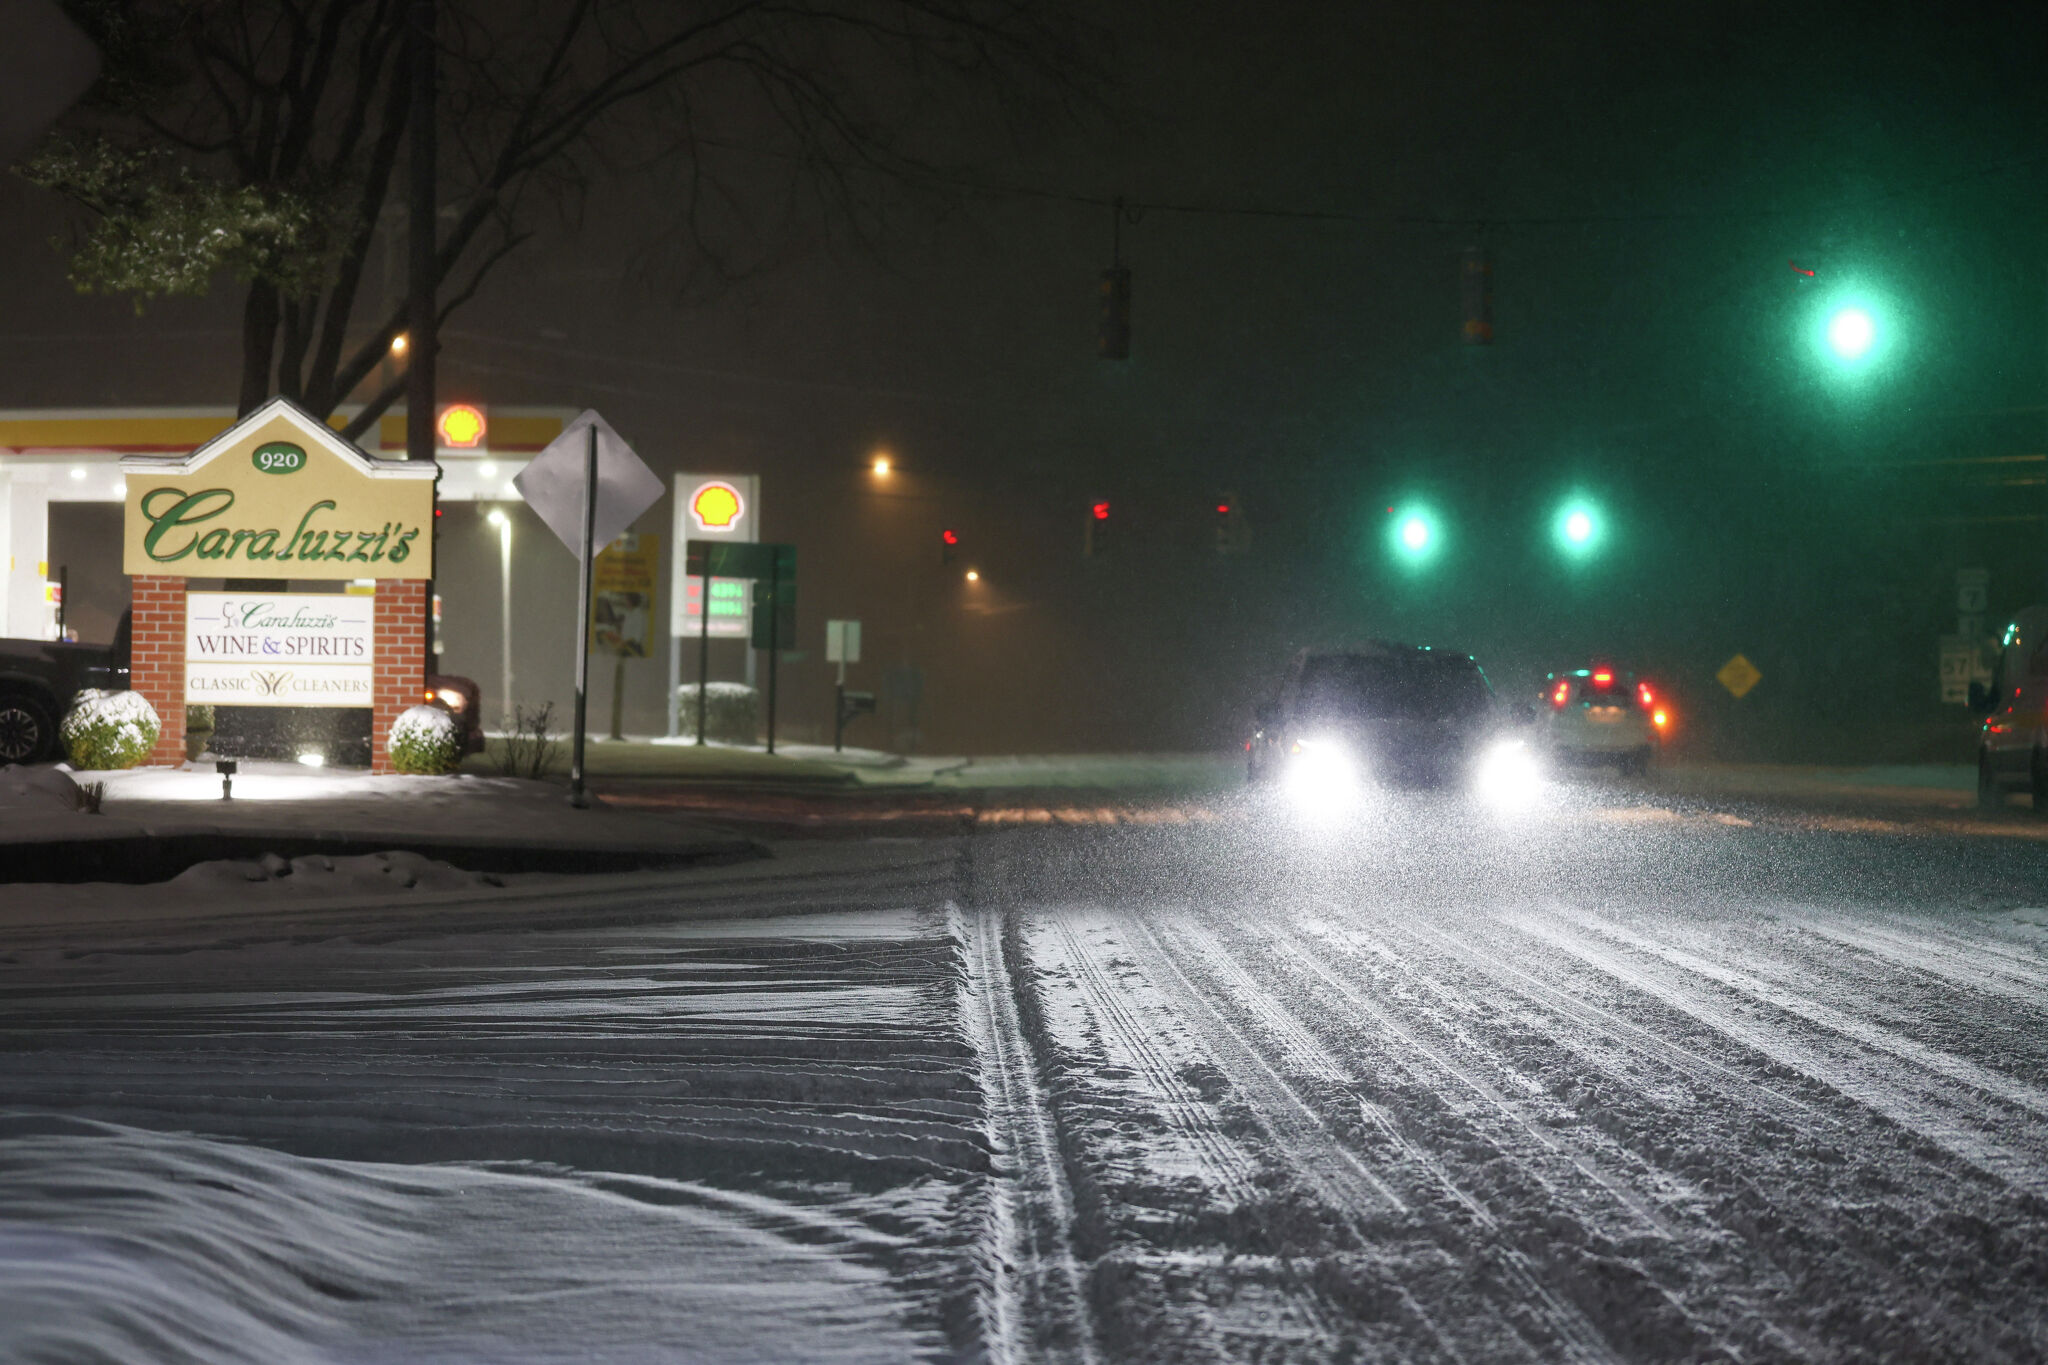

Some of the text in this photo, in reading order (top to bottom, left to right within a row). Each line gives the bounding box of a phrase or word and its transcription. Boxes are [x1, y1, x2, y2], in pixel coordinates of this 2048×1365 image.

[260, 452, 299, 470] 920
[141, 487, 419, 563] Caraluzzi's
[240, 602, 338, 629] Caraluzzi's
[197, 635, 365, 657] WINE & SPIRITS
[190, 677, 369, 693] CLASSIC CLEANERS
